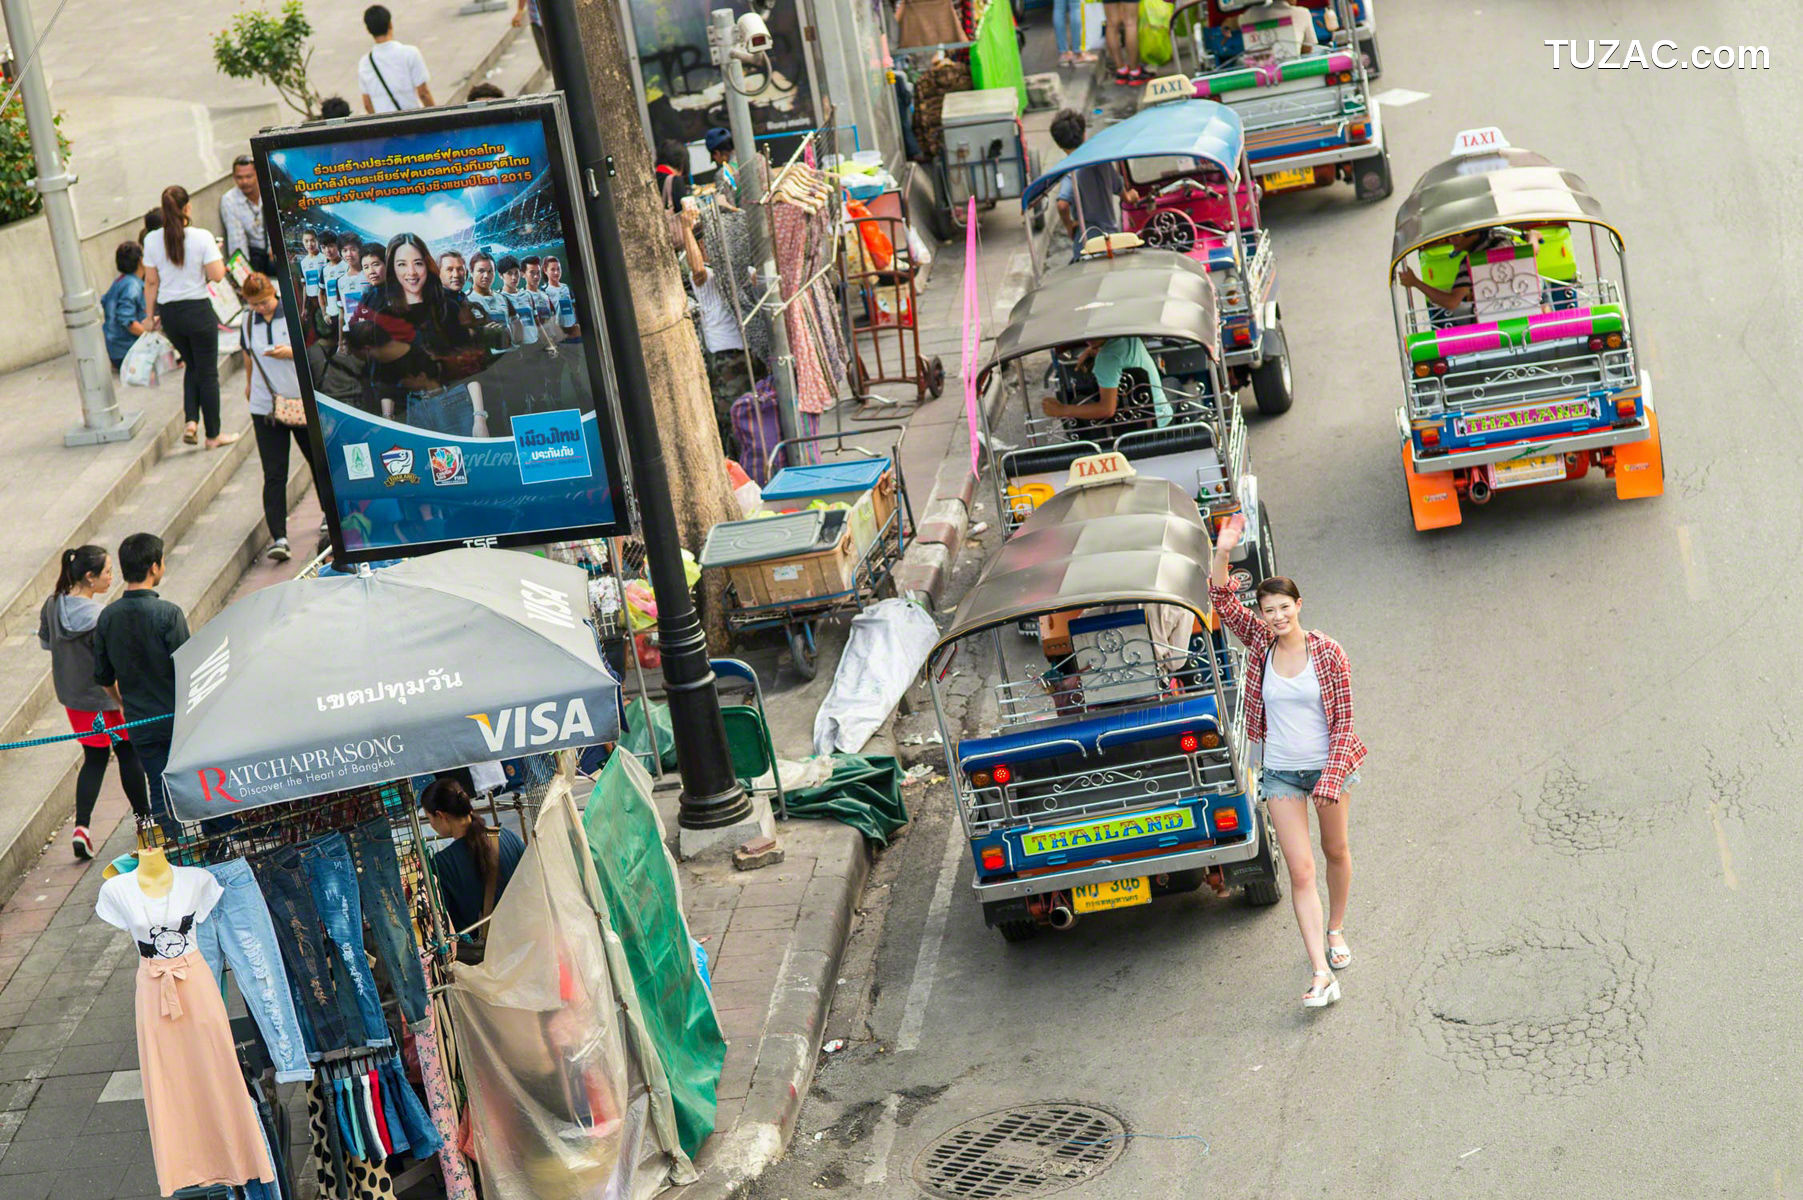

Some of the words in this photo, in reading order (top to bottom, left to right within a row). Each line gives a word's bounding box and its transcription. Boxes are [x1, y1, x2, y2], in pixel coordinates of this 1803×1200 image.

[1153, 80, 1182, 95] TAXI
[1462, 131, 1496, 147] TAXI
[501, 171, 532, 184] 2015
[1466, 403, 1588, 432] THAILAND
[519, 427, 580, 447] เมืองไทย
[1075, 456, 1119, 477] TAXI
[462, 536, 498, 549] TSF
[519, 578, 576, 630] VISA
[186, 634, 231, 716] VISA
[316, 668, 463, 713] เขตปทุมวัน
[466, 697, 595, 753] VISA
[196, 734, 405, 803] RATCHAPRASONG
[239, 780, 285, 798] Discover
[287, 774, 303, 787] the
[306, 770, 335, 783] Heart
[338, 764, 349, 777] of
[352, 757, 396, 775] Bangkok
[1032, 812, 1184, 851] THAILAND
